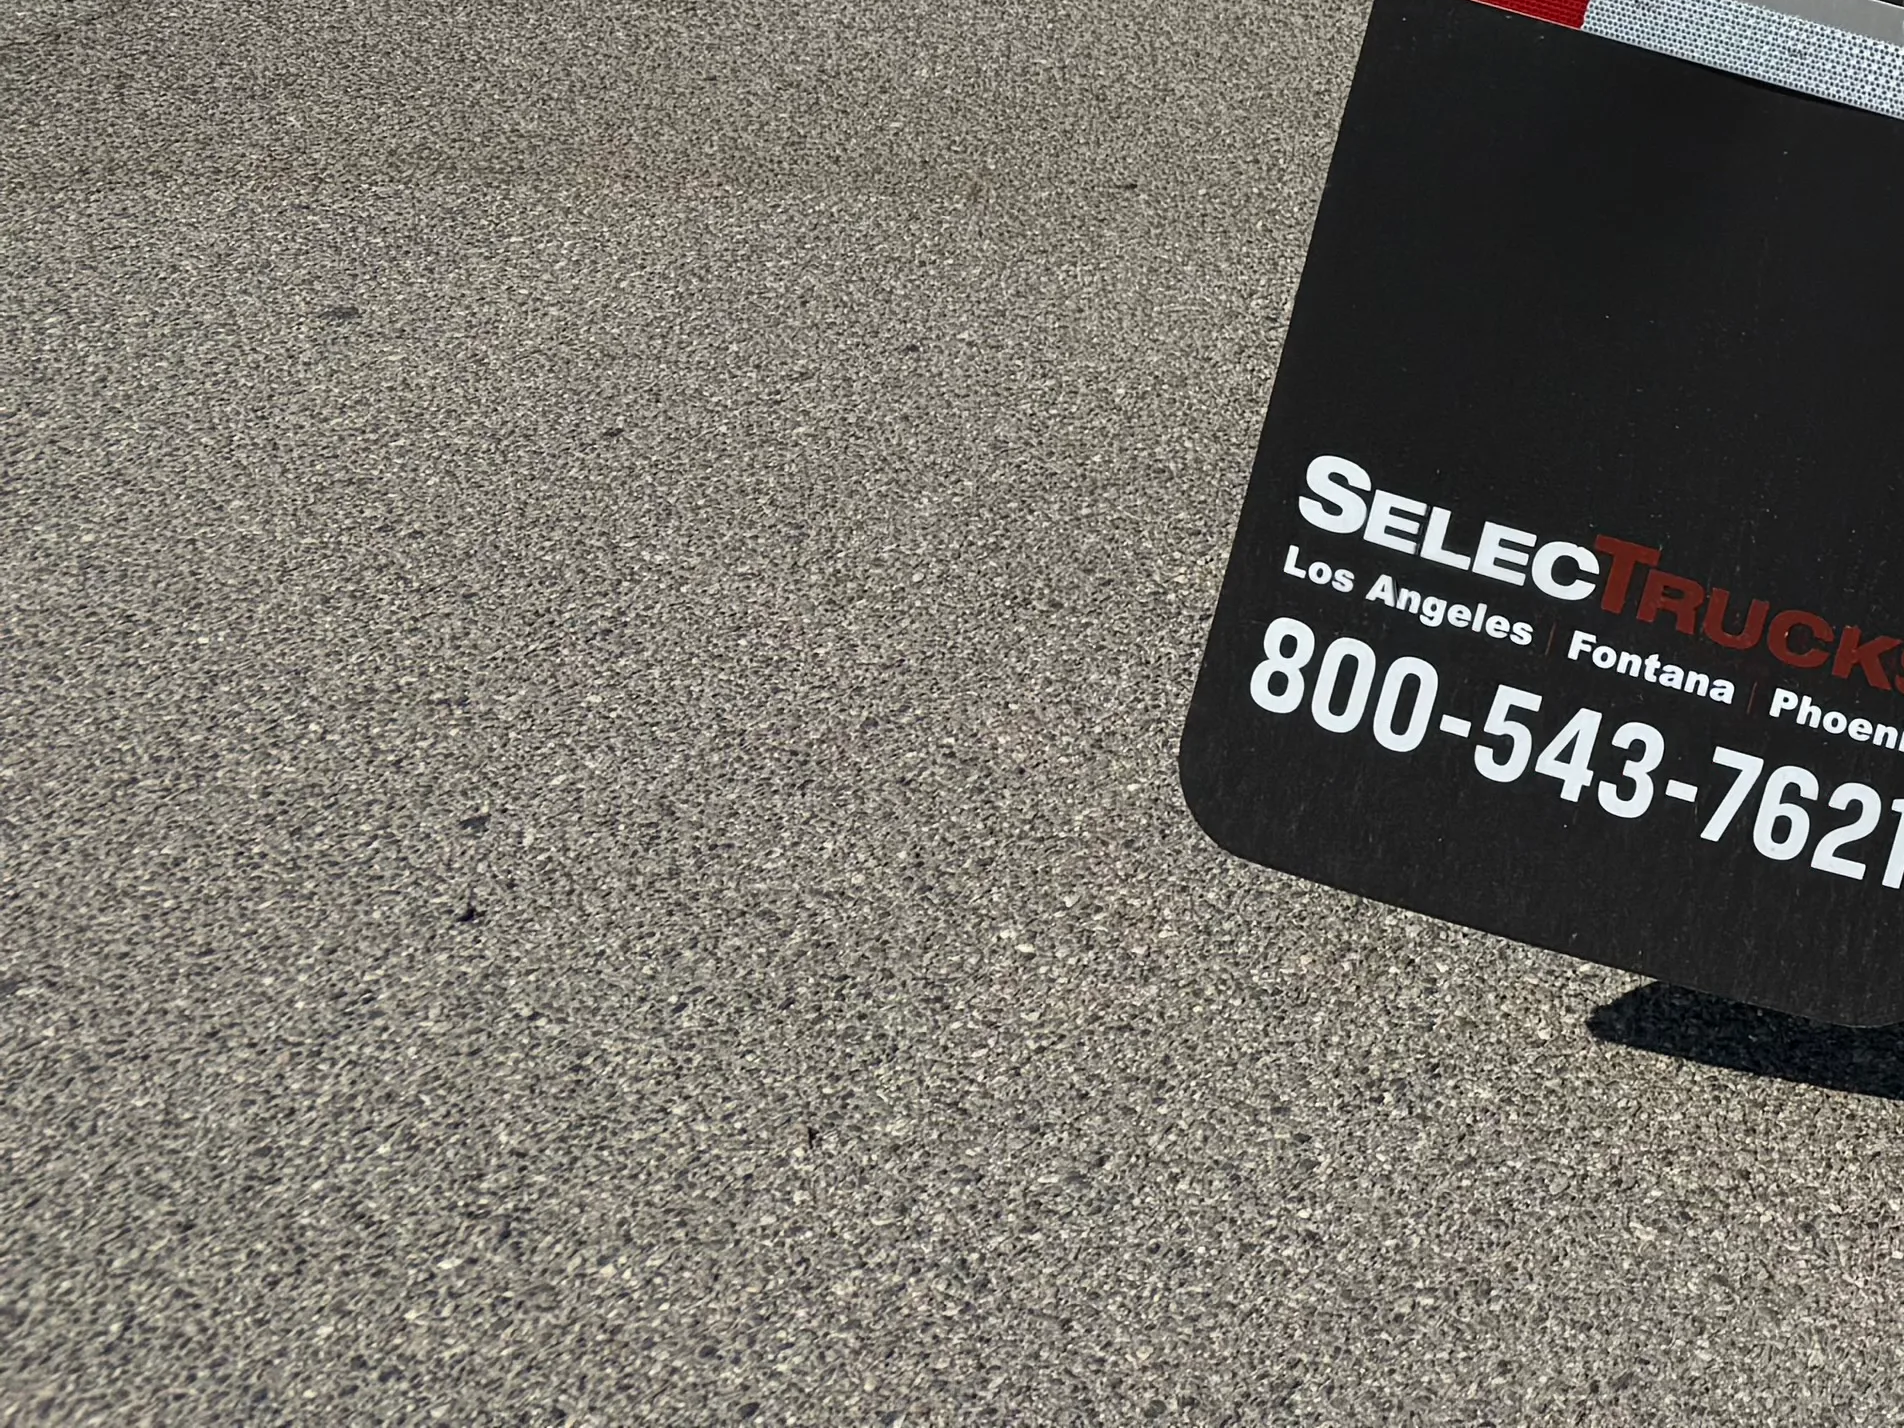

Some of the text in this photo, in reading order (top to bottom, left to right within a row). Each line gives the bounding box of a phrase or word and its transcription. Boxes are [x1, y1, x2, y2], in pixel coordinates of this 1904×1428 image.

[1283, 545, 1356, 594] Los
[1366, 573, 1535, 647] Angeles
[1568, 630, 1736, 705] Fontana
